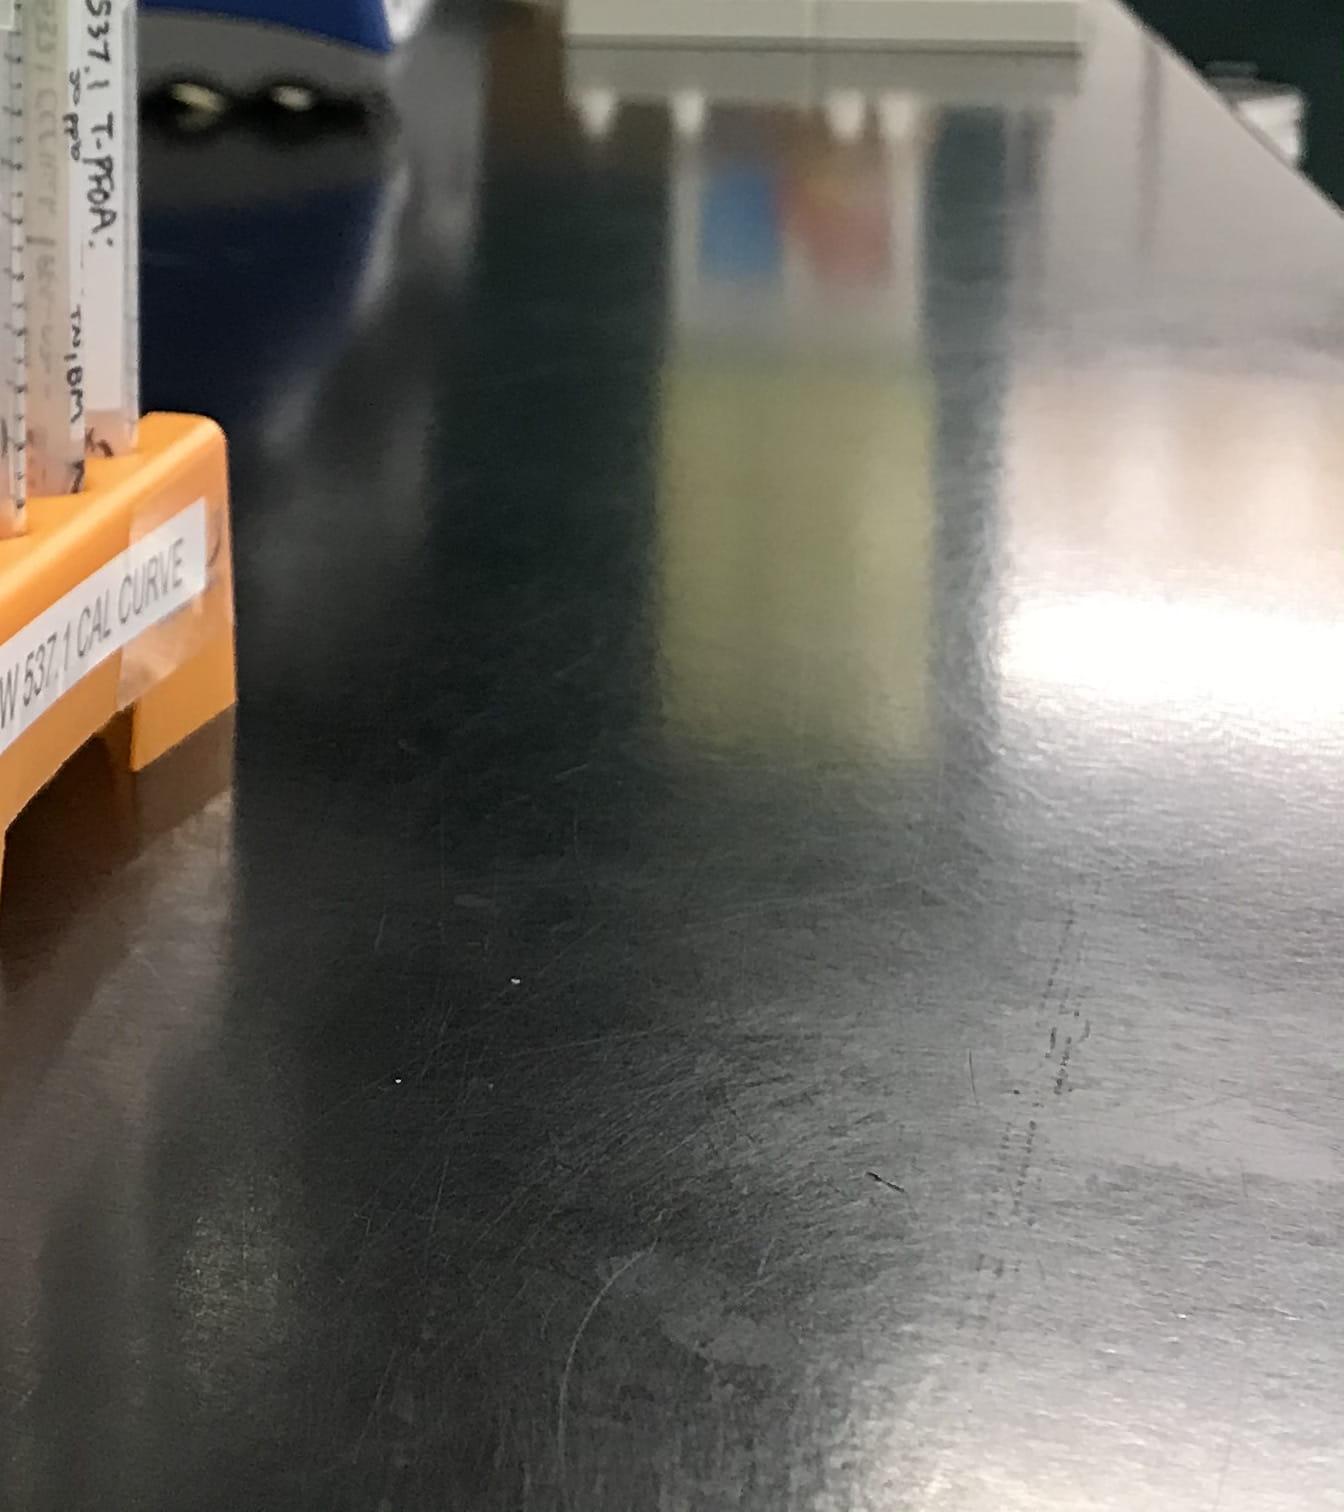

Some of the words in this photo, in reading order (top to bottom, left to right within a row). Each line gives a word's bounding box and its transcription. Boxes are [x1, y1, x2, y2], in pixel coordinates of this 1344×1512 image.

[22, 620, 72, 707] 537.1
[76, 588, 112, 659] CAL
[117, 537, 185, 625] CURVE
